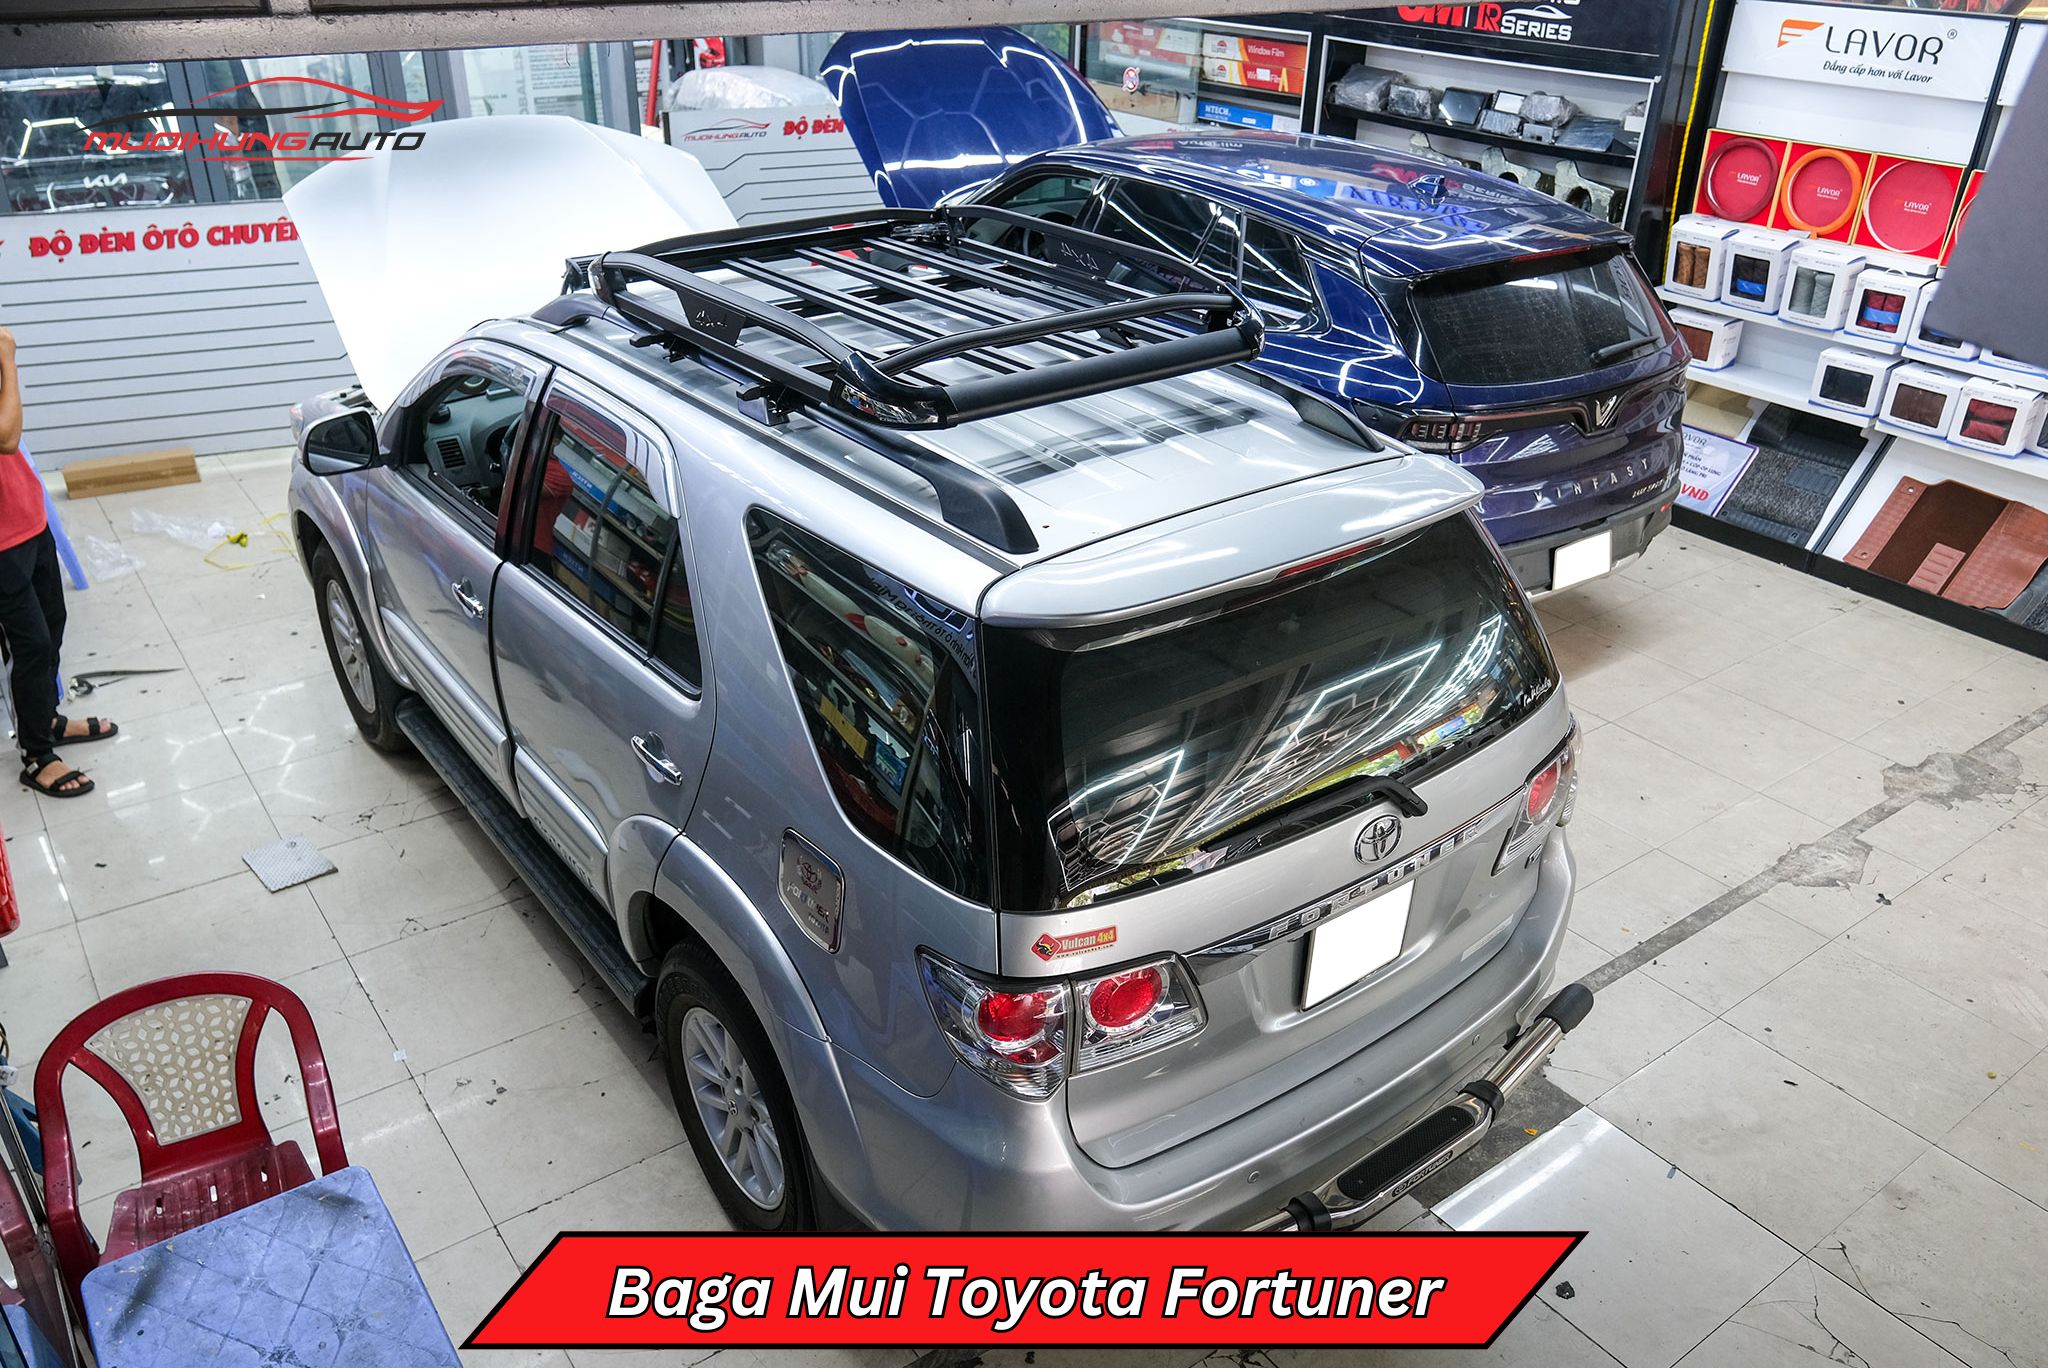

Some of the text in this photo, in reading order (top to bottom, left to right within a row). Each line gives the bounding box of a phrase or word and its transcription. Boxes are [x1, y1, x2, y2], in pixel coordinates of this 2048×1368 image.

[1500, 15, 1572, 41] SERIES
[1247, 44, 1285, 57] Window Film
[1825, 25, 1944, 65] LAVOR
[1904, 71, 1933, 83] Lavor
[783, 114, 844, 140] ĐỘ ĐÈN
[1737, 172, 1760, 182] LAVOR
[1817, 187, 1840, 197] LAVOR
[1904, 201, 1929, 211] LAVOR
[29, 229, 73, 263] ĐỘ
[79, 226, 136, 255] ĐÈN
[143, 221, 200, 251] ÔTÔ
[1682, 432, 1707, 446] AVOR
[1681, 484, 1709, 501] VND
[1268, 828, 1478, 940] FORTUNER
[1062, 929, 1115, 950] Vulcan 4x4
